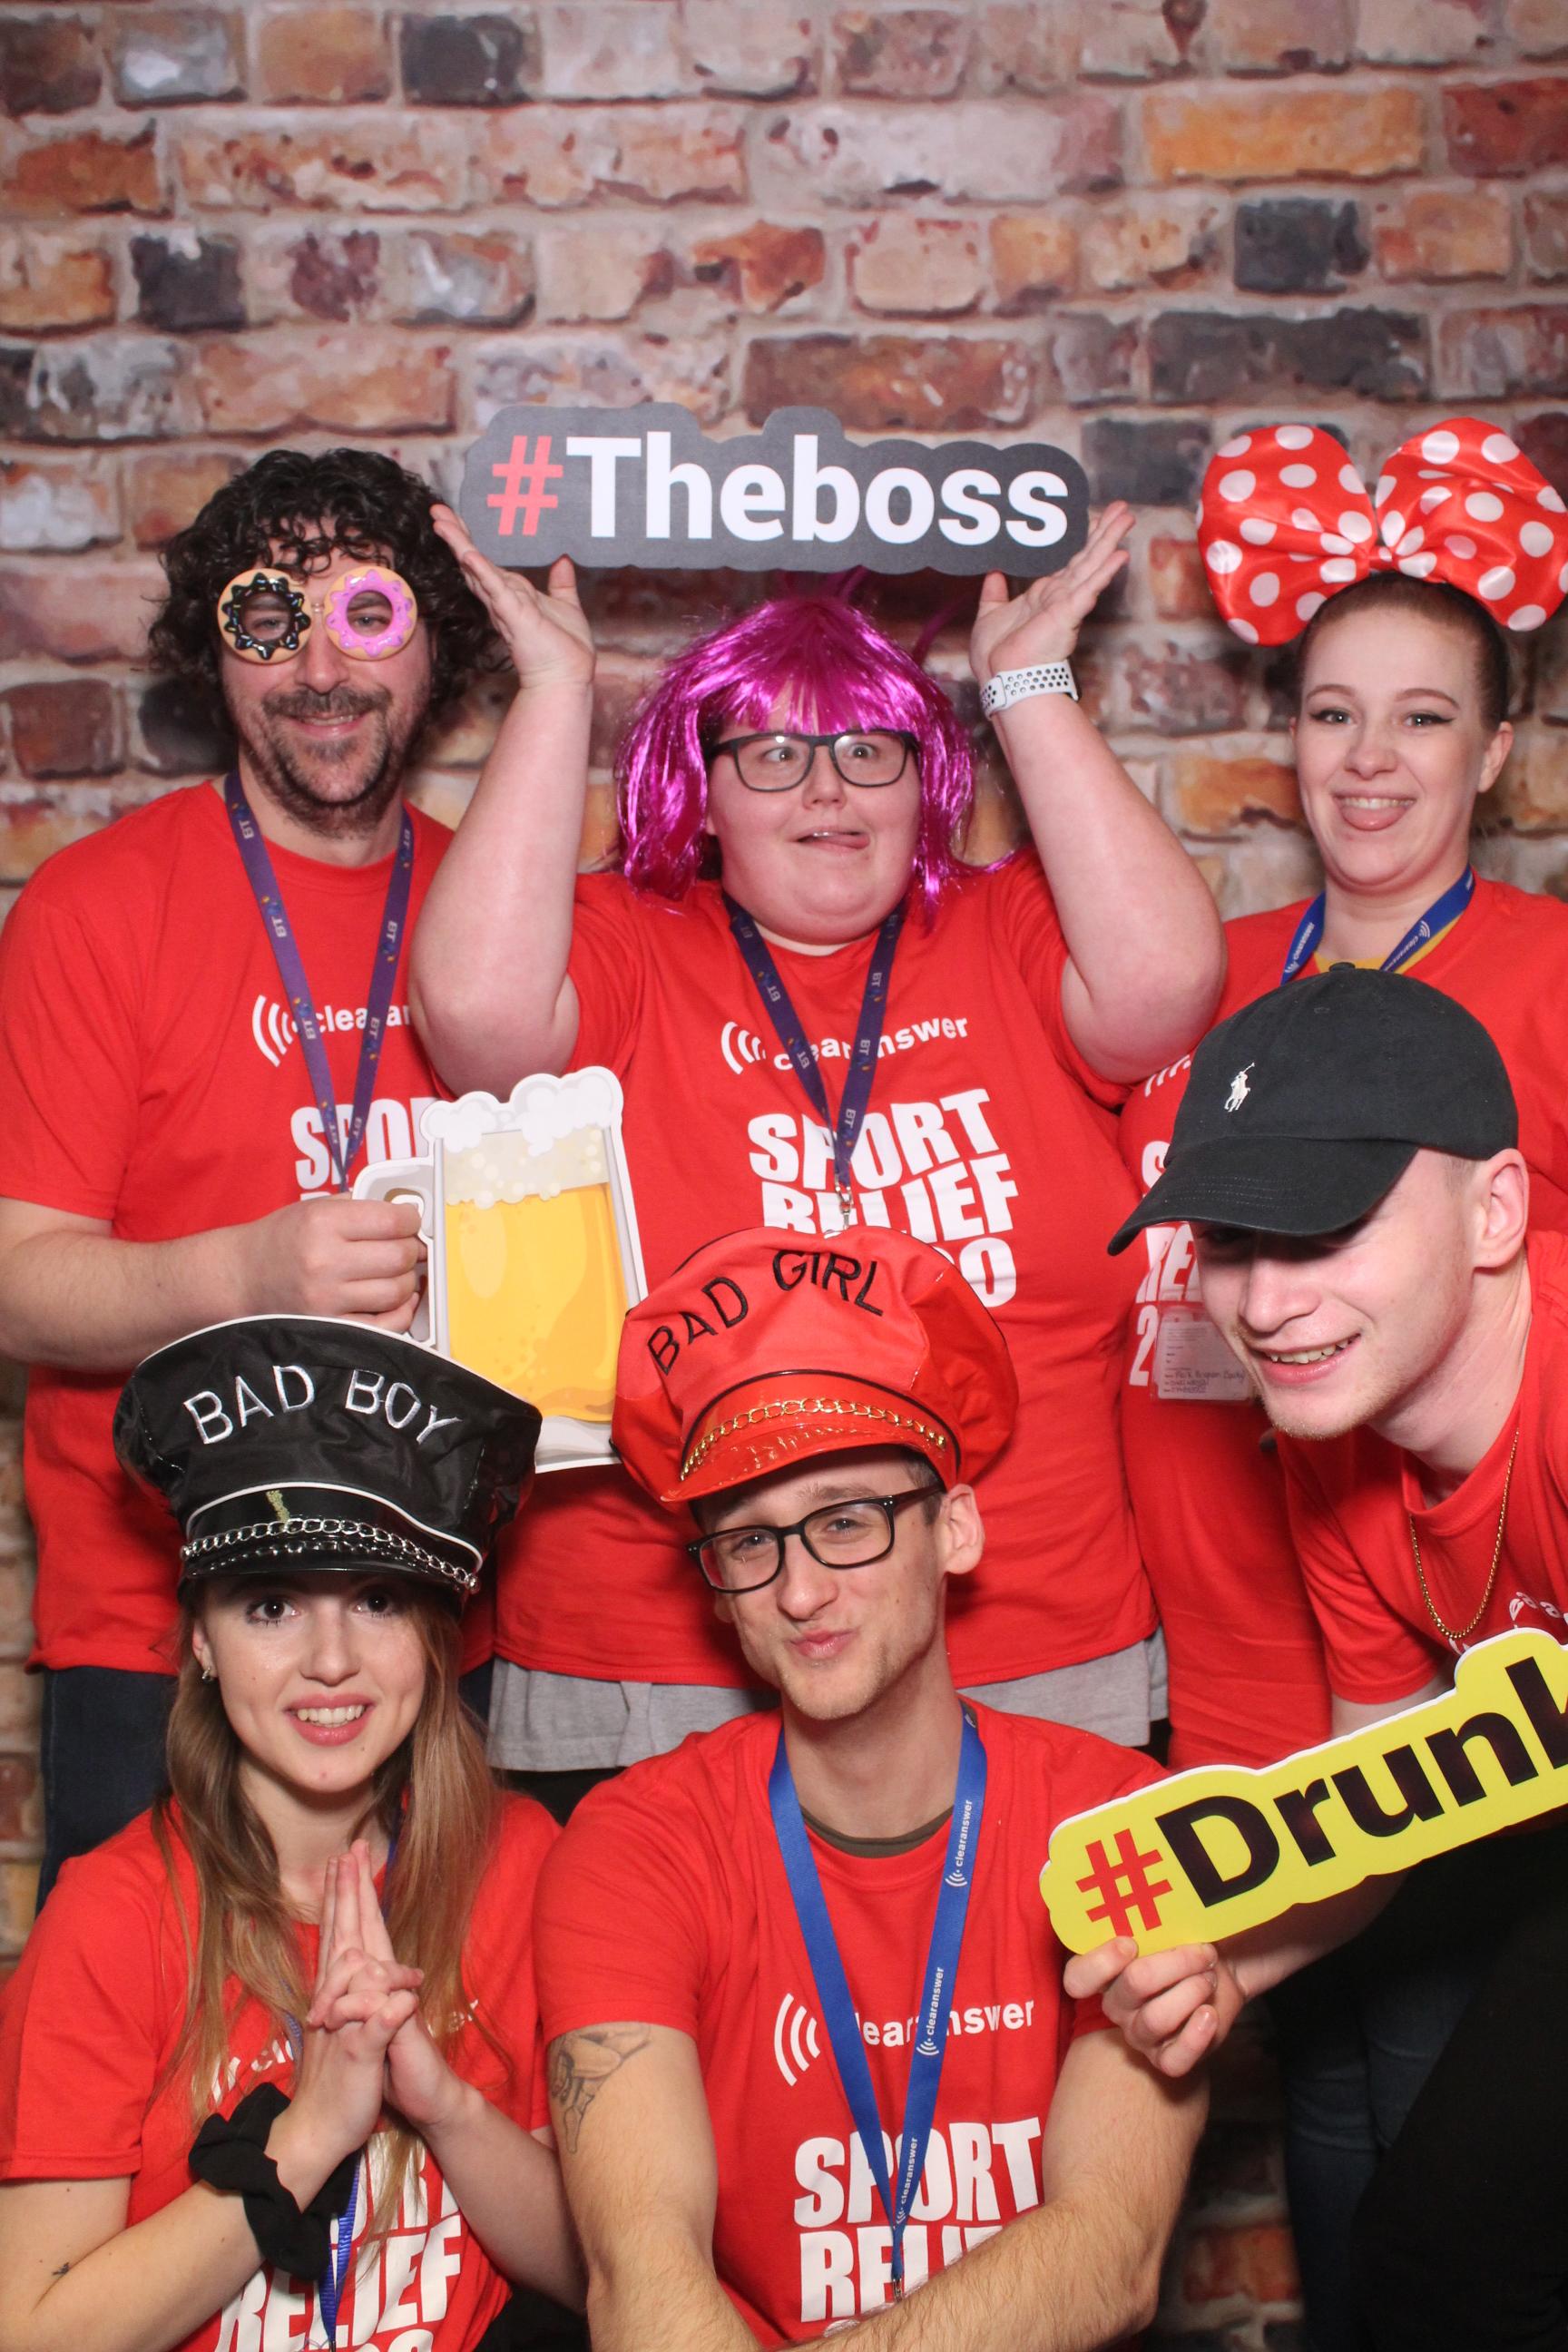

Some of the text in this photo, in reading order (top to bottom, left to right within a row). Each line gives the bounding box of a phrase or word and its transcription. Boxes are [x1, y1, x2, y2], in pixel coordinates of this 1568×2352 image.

[486, 431, 1069, 547] #Theboss
[239, 819, 255, 839] BT
[271, 916, 288, 938] BT
[386, 920, 398, 943] BT
[766, 985, 781, 1003] BT
[871, 972, 883, 987] BT
[797, 1050, 810, 1070] BT
[858, 1039, 871, 1056] BT
[747, 1088, 1001, 1191] SPORT
[845, 1108, 857, 1129] BT
[647, 1249, 884, 1377] BAD GIRL
[183, 1365, 463, 1446] BAD BOY
[955, 1799, 973, 1867] clearanswer
[926, 1966, 945, 2036] clearanswer
[793, 2116, 1042, 2229] SPORT
[901, 2137, 918, 2206] clearanswer
